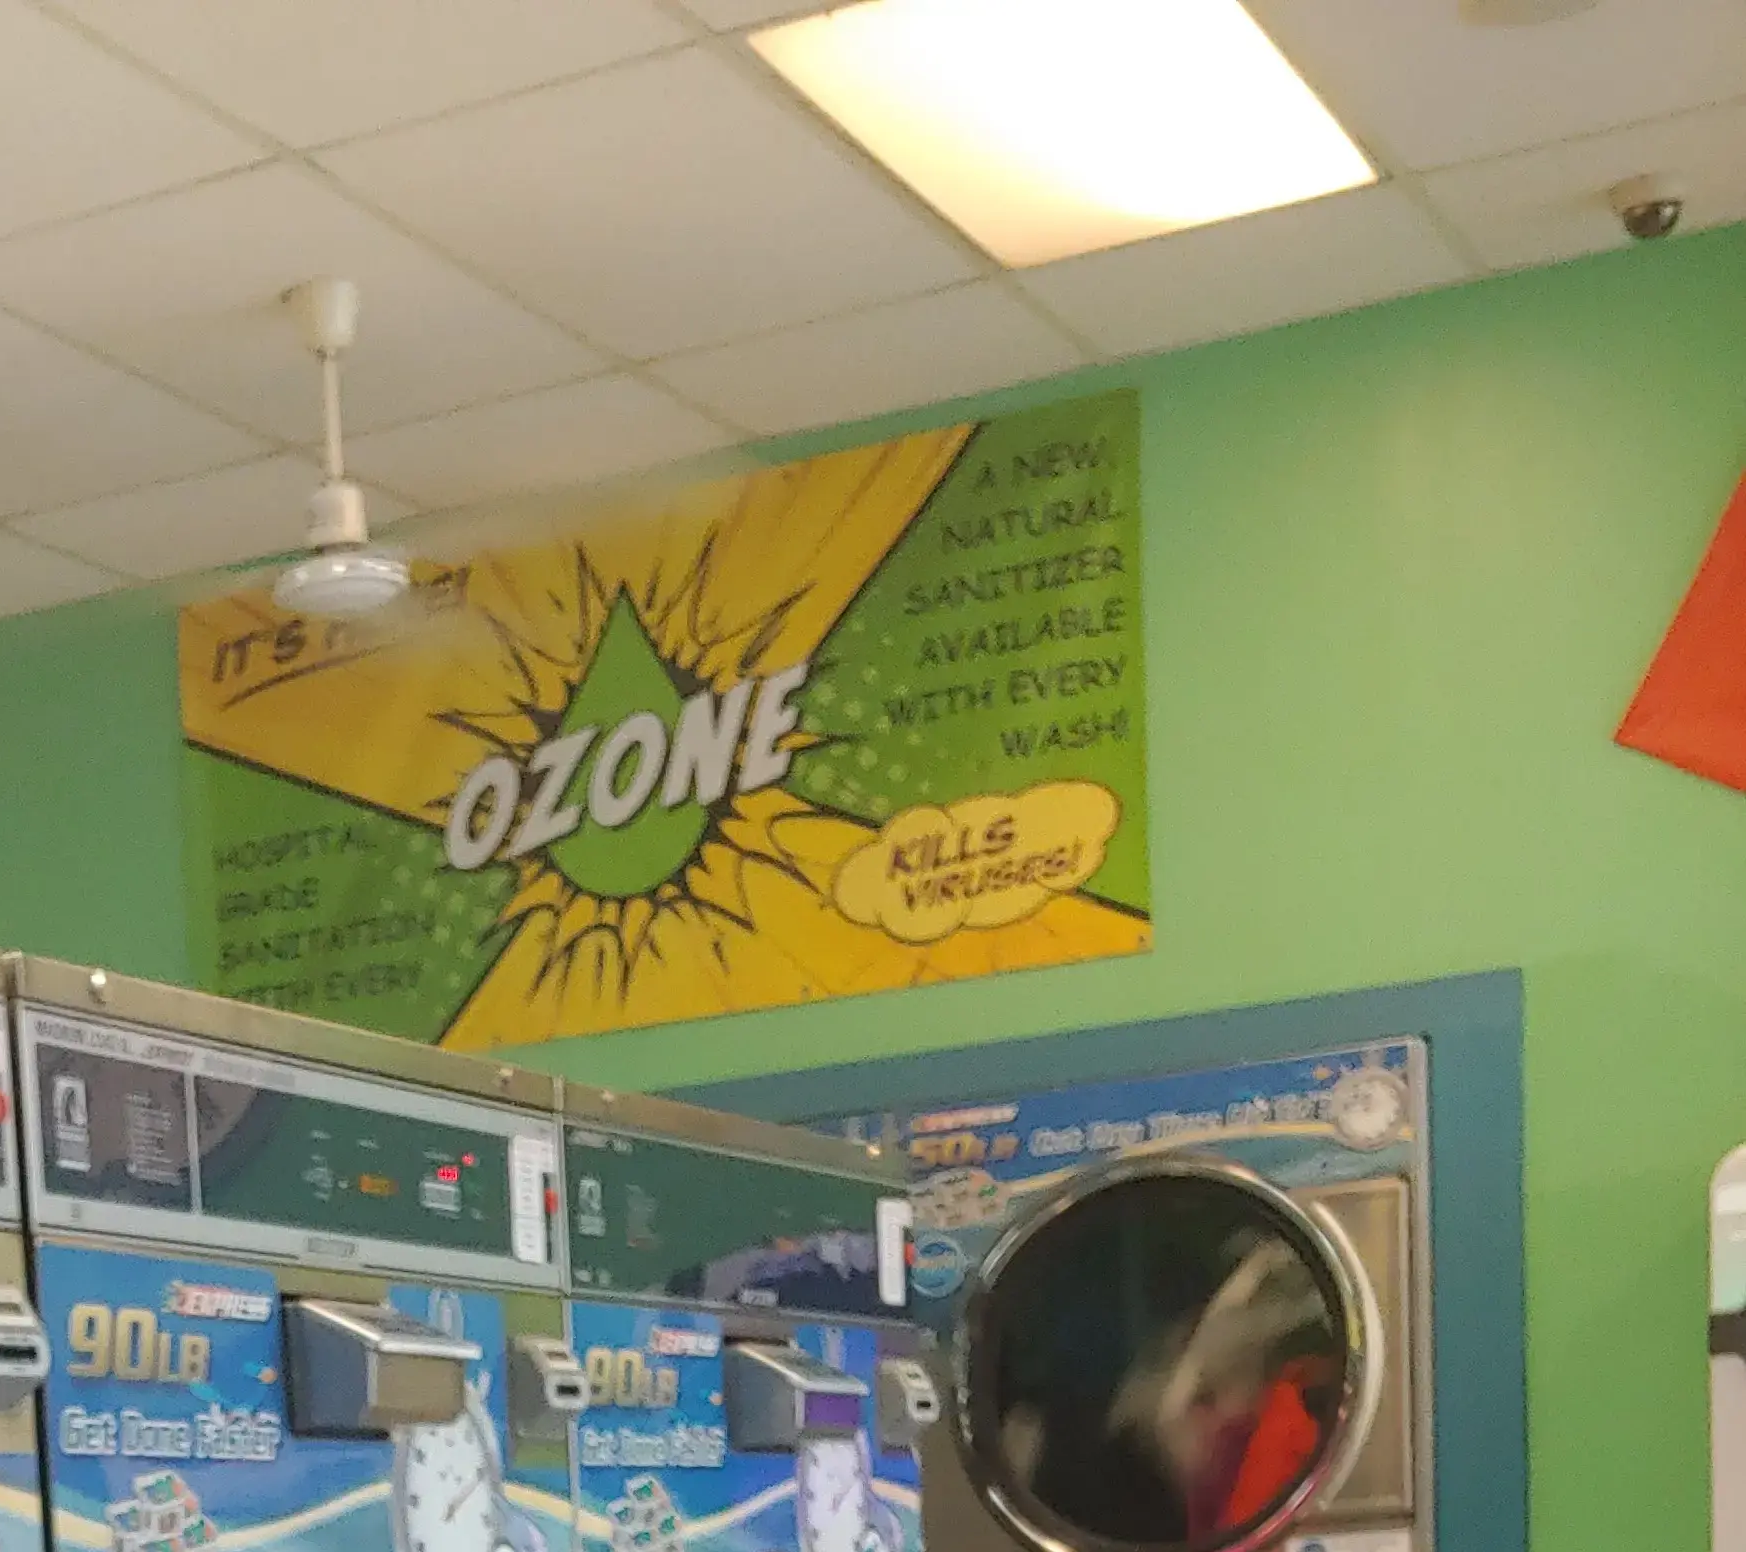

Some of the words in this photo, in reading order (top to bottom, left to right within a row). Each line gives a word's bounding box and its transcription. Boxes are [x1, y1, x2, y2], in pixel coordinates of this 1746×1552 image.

[943, 488, 1128, 550] NATURAL
[904, 546, 1127, 616] SANITIZER
[915, 597, 1128, 668] AVAILABLE
[883, 678, 996, 726] WITH
[1008, 653, 1129, 705] EVERY
[444, 663, 809, 870] OZONE
[885, 814, 1018, 882] KILLS
[903, 836, 1086, 912] VIRUSES!
